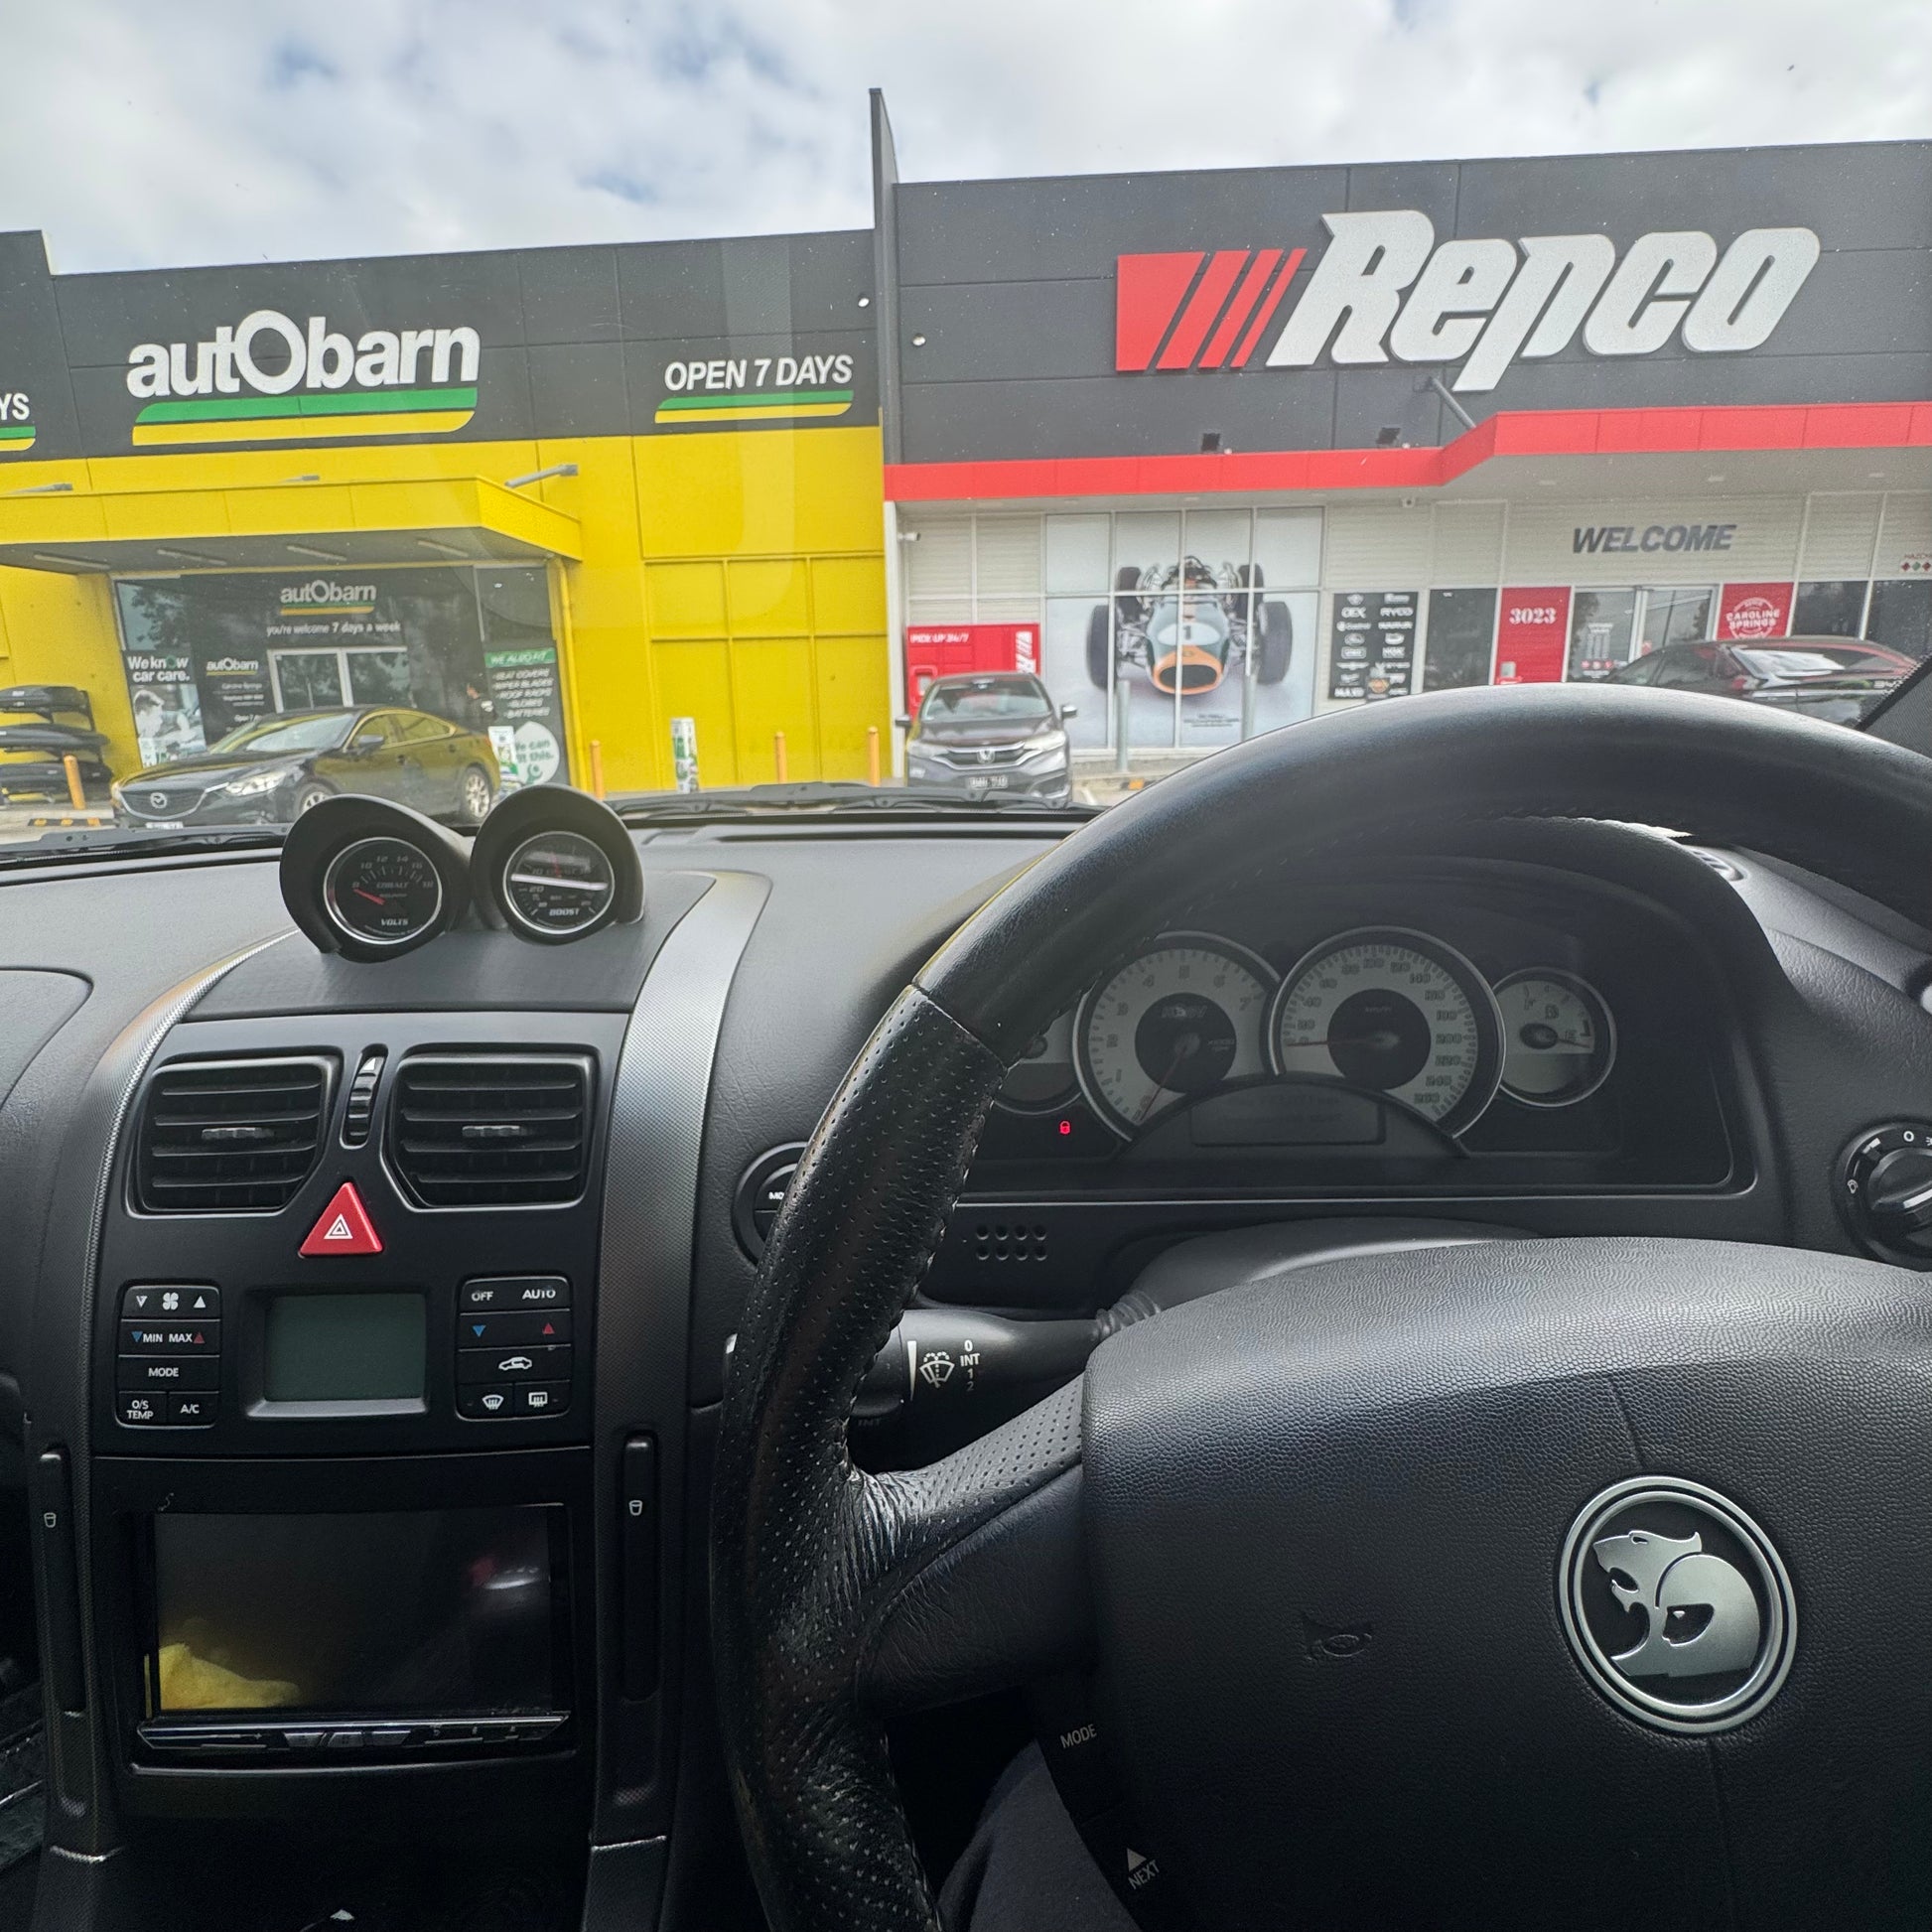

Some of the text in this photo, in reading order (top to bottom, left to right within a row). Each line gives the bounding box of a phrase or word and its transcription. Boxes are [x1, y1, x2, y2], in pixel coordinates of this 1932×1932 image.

[1265, 209, 1820, 393] Repco
[664, 355, 854, 391] OPEN 7 DAYS
[1573, 525, 1736, 553] WELCOME
[1509, 608, 1557, 624] 3023
[1725, 609, 1780, 621] CAROLINE
[332, 621, 340, 632] 7
[1729, 618, 1776, 629] SPRINGS
[127, 656, 149, 669] We
[133, 670, 191, 682] car care.
[549, 907, 580, 916] BOOST
[472, 1291, 494, 1302] OFF
[522, 1289, 556, 1300] AUTO
[142, 1333, 193, 1343] MIN MAX
[960, 1353, 981, 1367] INT
[148, 1367, 180, 1377] MODE
[967, 1368, 974, 1379] 1
[967, 1381, 974, 1391] 2
[131, 1400, 149, 1410] O/S
[180, 1404, 200, 1414] A/C
[126, 1410, 154, 1420] TEMP
[1059, 1724, 1098, 1748] MODE
[1128, 1859, 1161, 1889] NEXT
